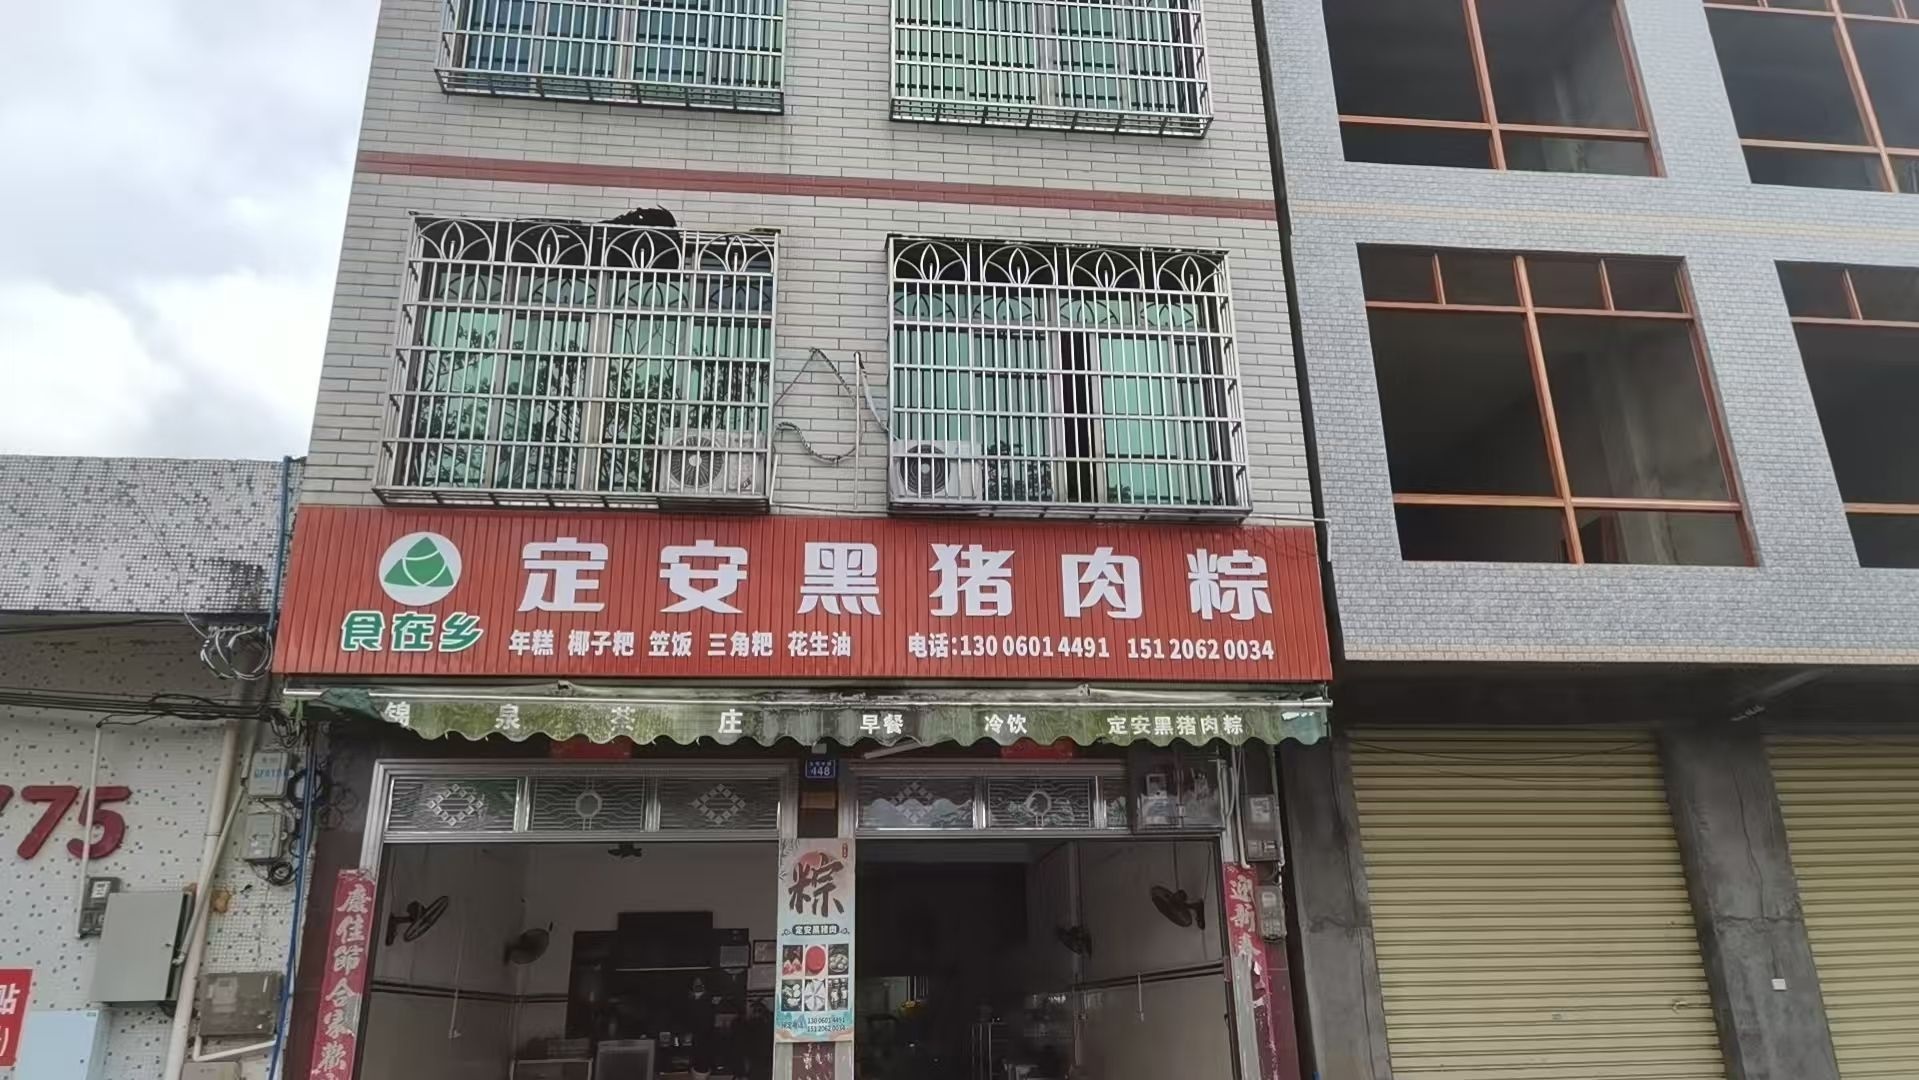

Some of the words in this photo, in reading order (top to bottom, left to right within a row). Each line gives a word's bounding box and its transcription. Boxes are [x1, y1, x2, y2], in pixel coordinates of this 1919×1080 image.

[517, 537, 1272, 621] 定安黑猪肉粽
[341, 610, 484, 652] 食在乡
[508, 629, 554, 656] 年糕
[567, 629, 635, 657] 椰子粑
[707, 631, 774, 657] 三角粑
[787, 631, 851, 657] 花生油
[860, 713, 904, 735] 早餐
[984, 713, 1028, 735] 冷饮
[1106, 714, 1244, 736] 定安黑猪肉粽
[0, 784, 133, 861] 75
[788, 852, 845, 918] 粽
